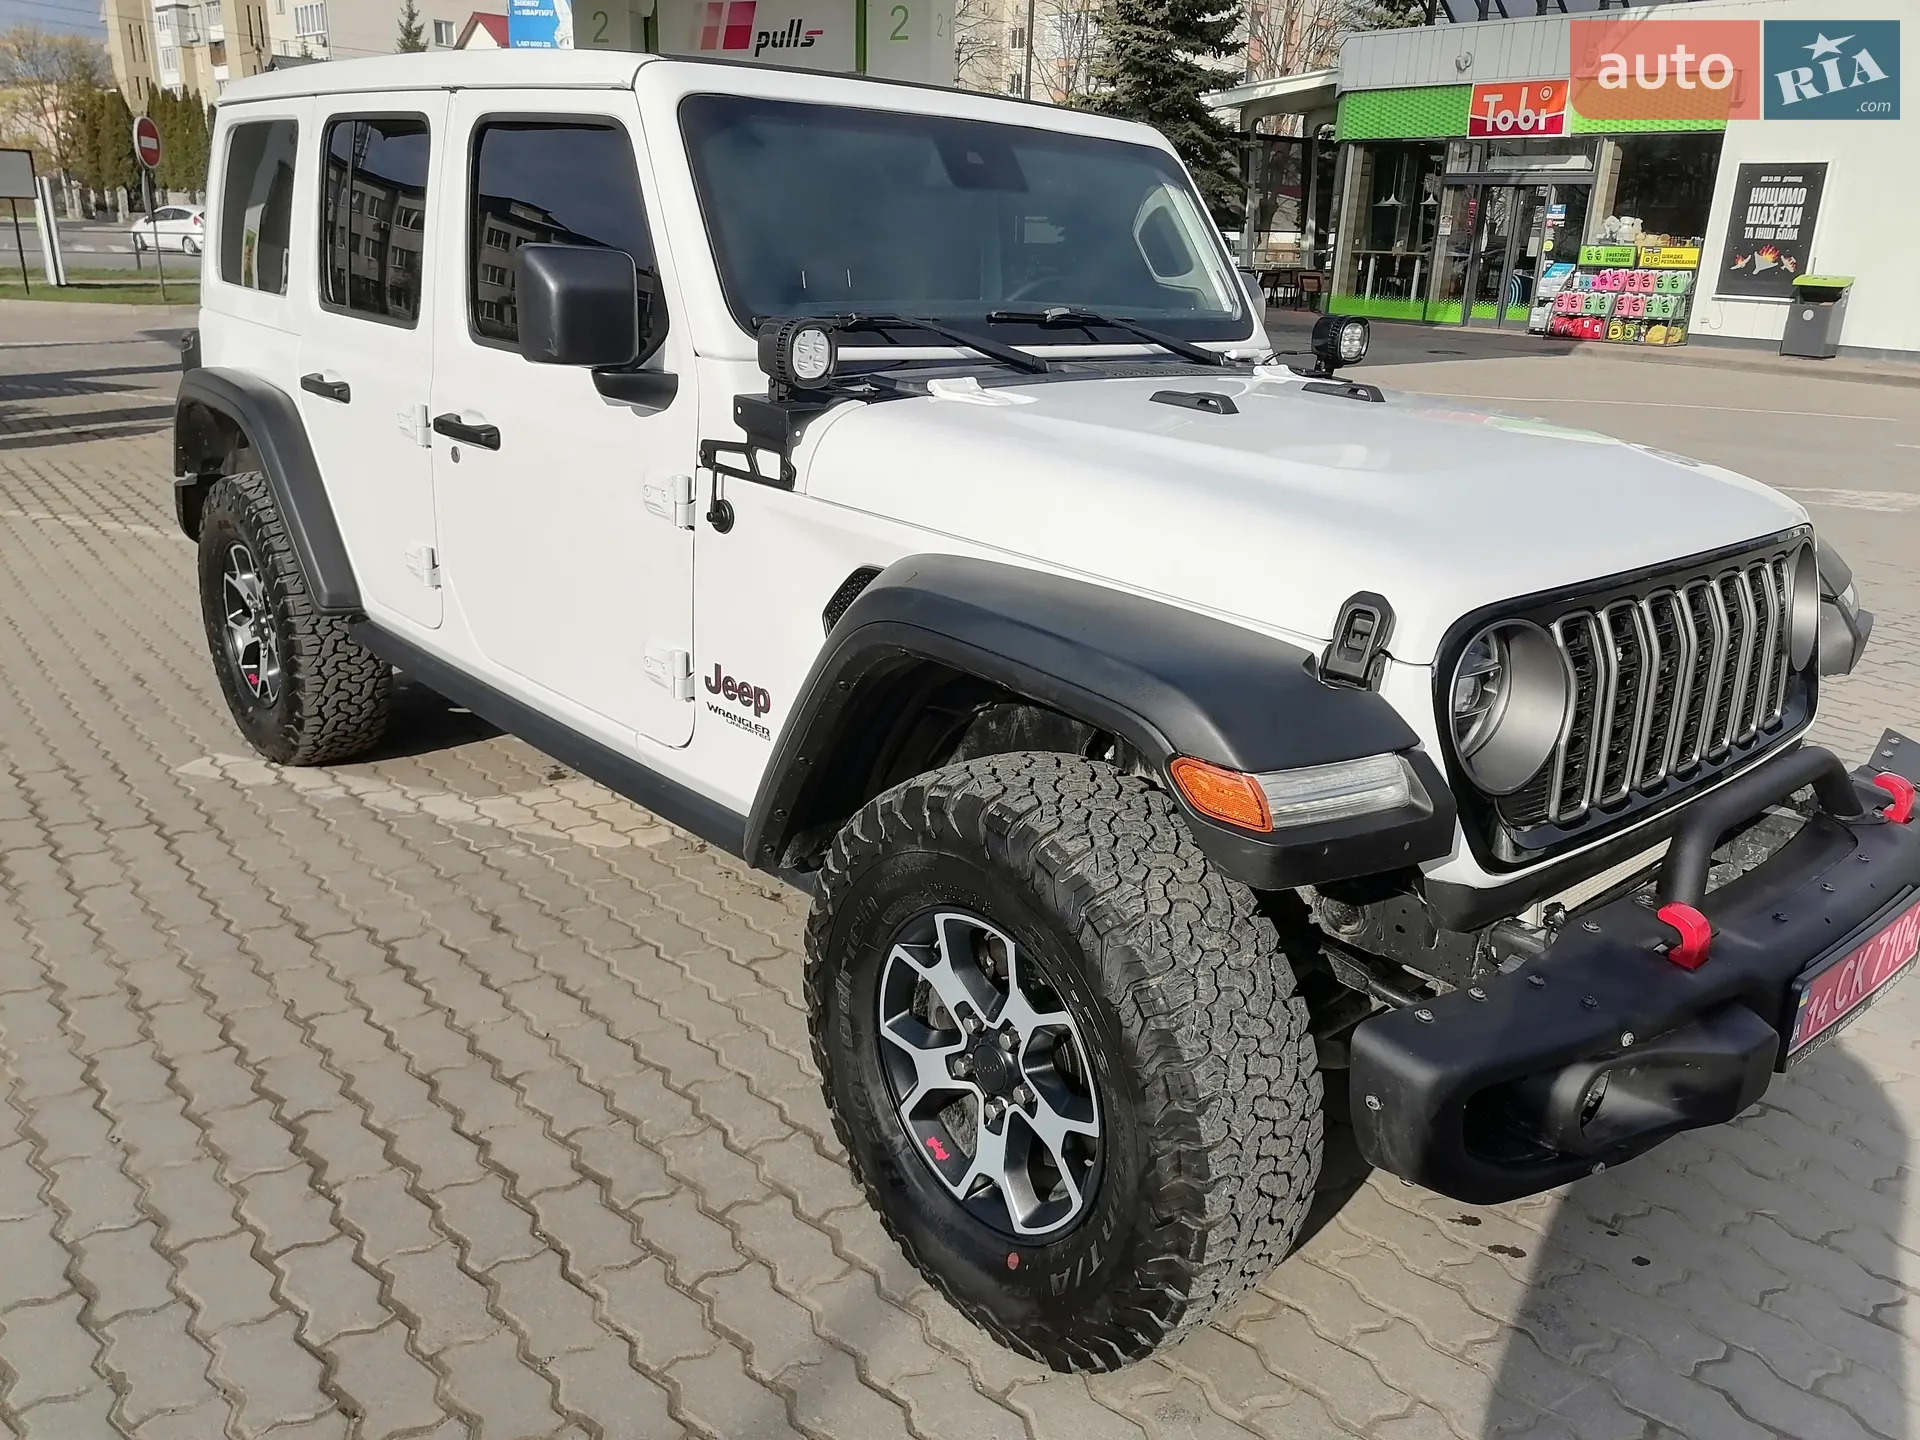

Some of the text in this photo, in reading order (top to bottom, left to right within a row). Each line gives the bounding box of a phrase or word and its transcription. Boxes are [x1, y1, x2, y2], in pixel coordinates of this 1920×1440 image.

[522, 9, 555, 17] КВАРТИРУ
[592, 10, 610, 43] 2
[889, 5, 909, 41] 2
[754, 18, 824, 58] pulls
[1482, 85, 1553, 132] Tobi
[1749, 187, 1808, 207] НИЩИМО
[1743, 226, 1800, 241] ТА ІНШІ БПЛА
[1745, 205, 1804, 228] ШАХЕДИ
[704, 662, 771, 718] Jeep
[706, 700, 771, 737] WRANGLER
[725, 718, 771, 742] UNLIMITED
[1806, 987, 1832, 1034] 14
[1834, 943, 1874, 1010] CK
[1870, 904, 1920, 985] 7104
